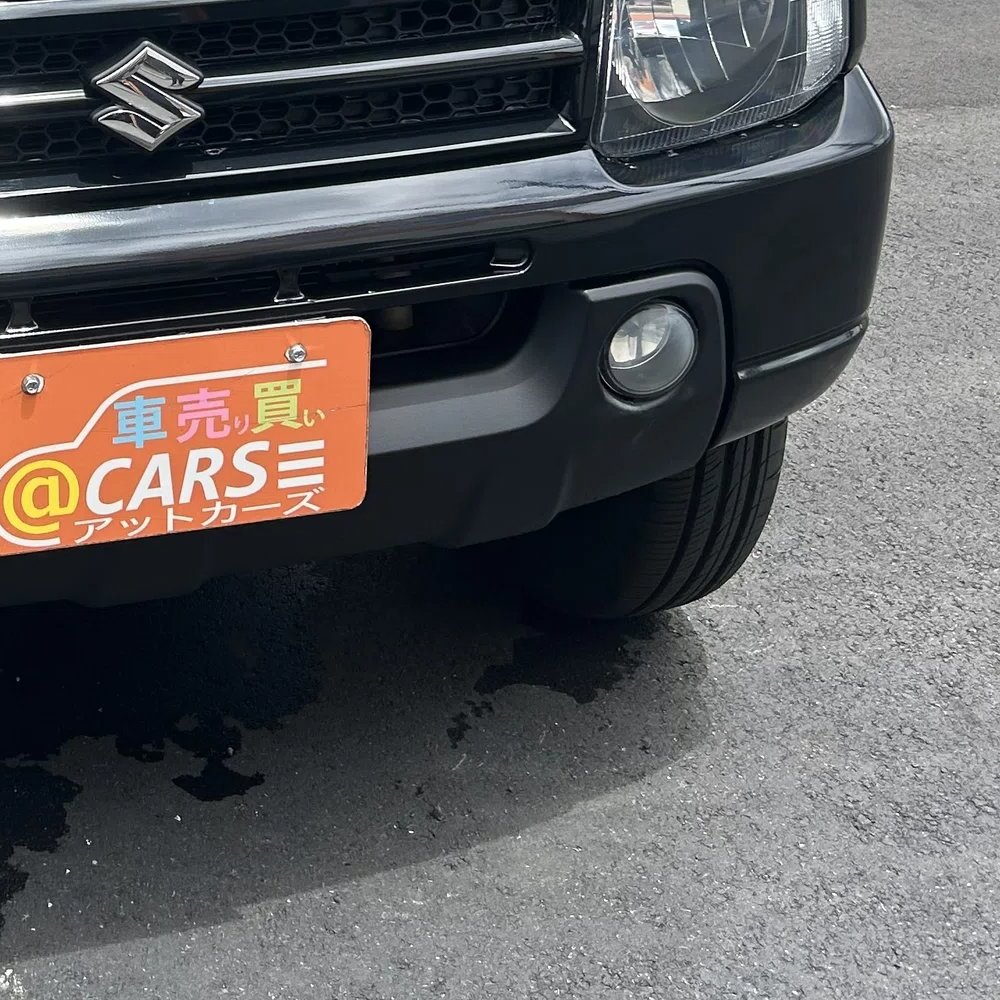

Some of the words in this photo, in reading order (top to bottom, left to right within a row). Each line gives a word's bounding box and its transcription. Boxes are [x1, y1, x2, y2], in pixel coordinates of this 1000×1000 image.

[112, 378, 326, 449] 車売り買い
[73, 487, 326, 546] アットカーズ
